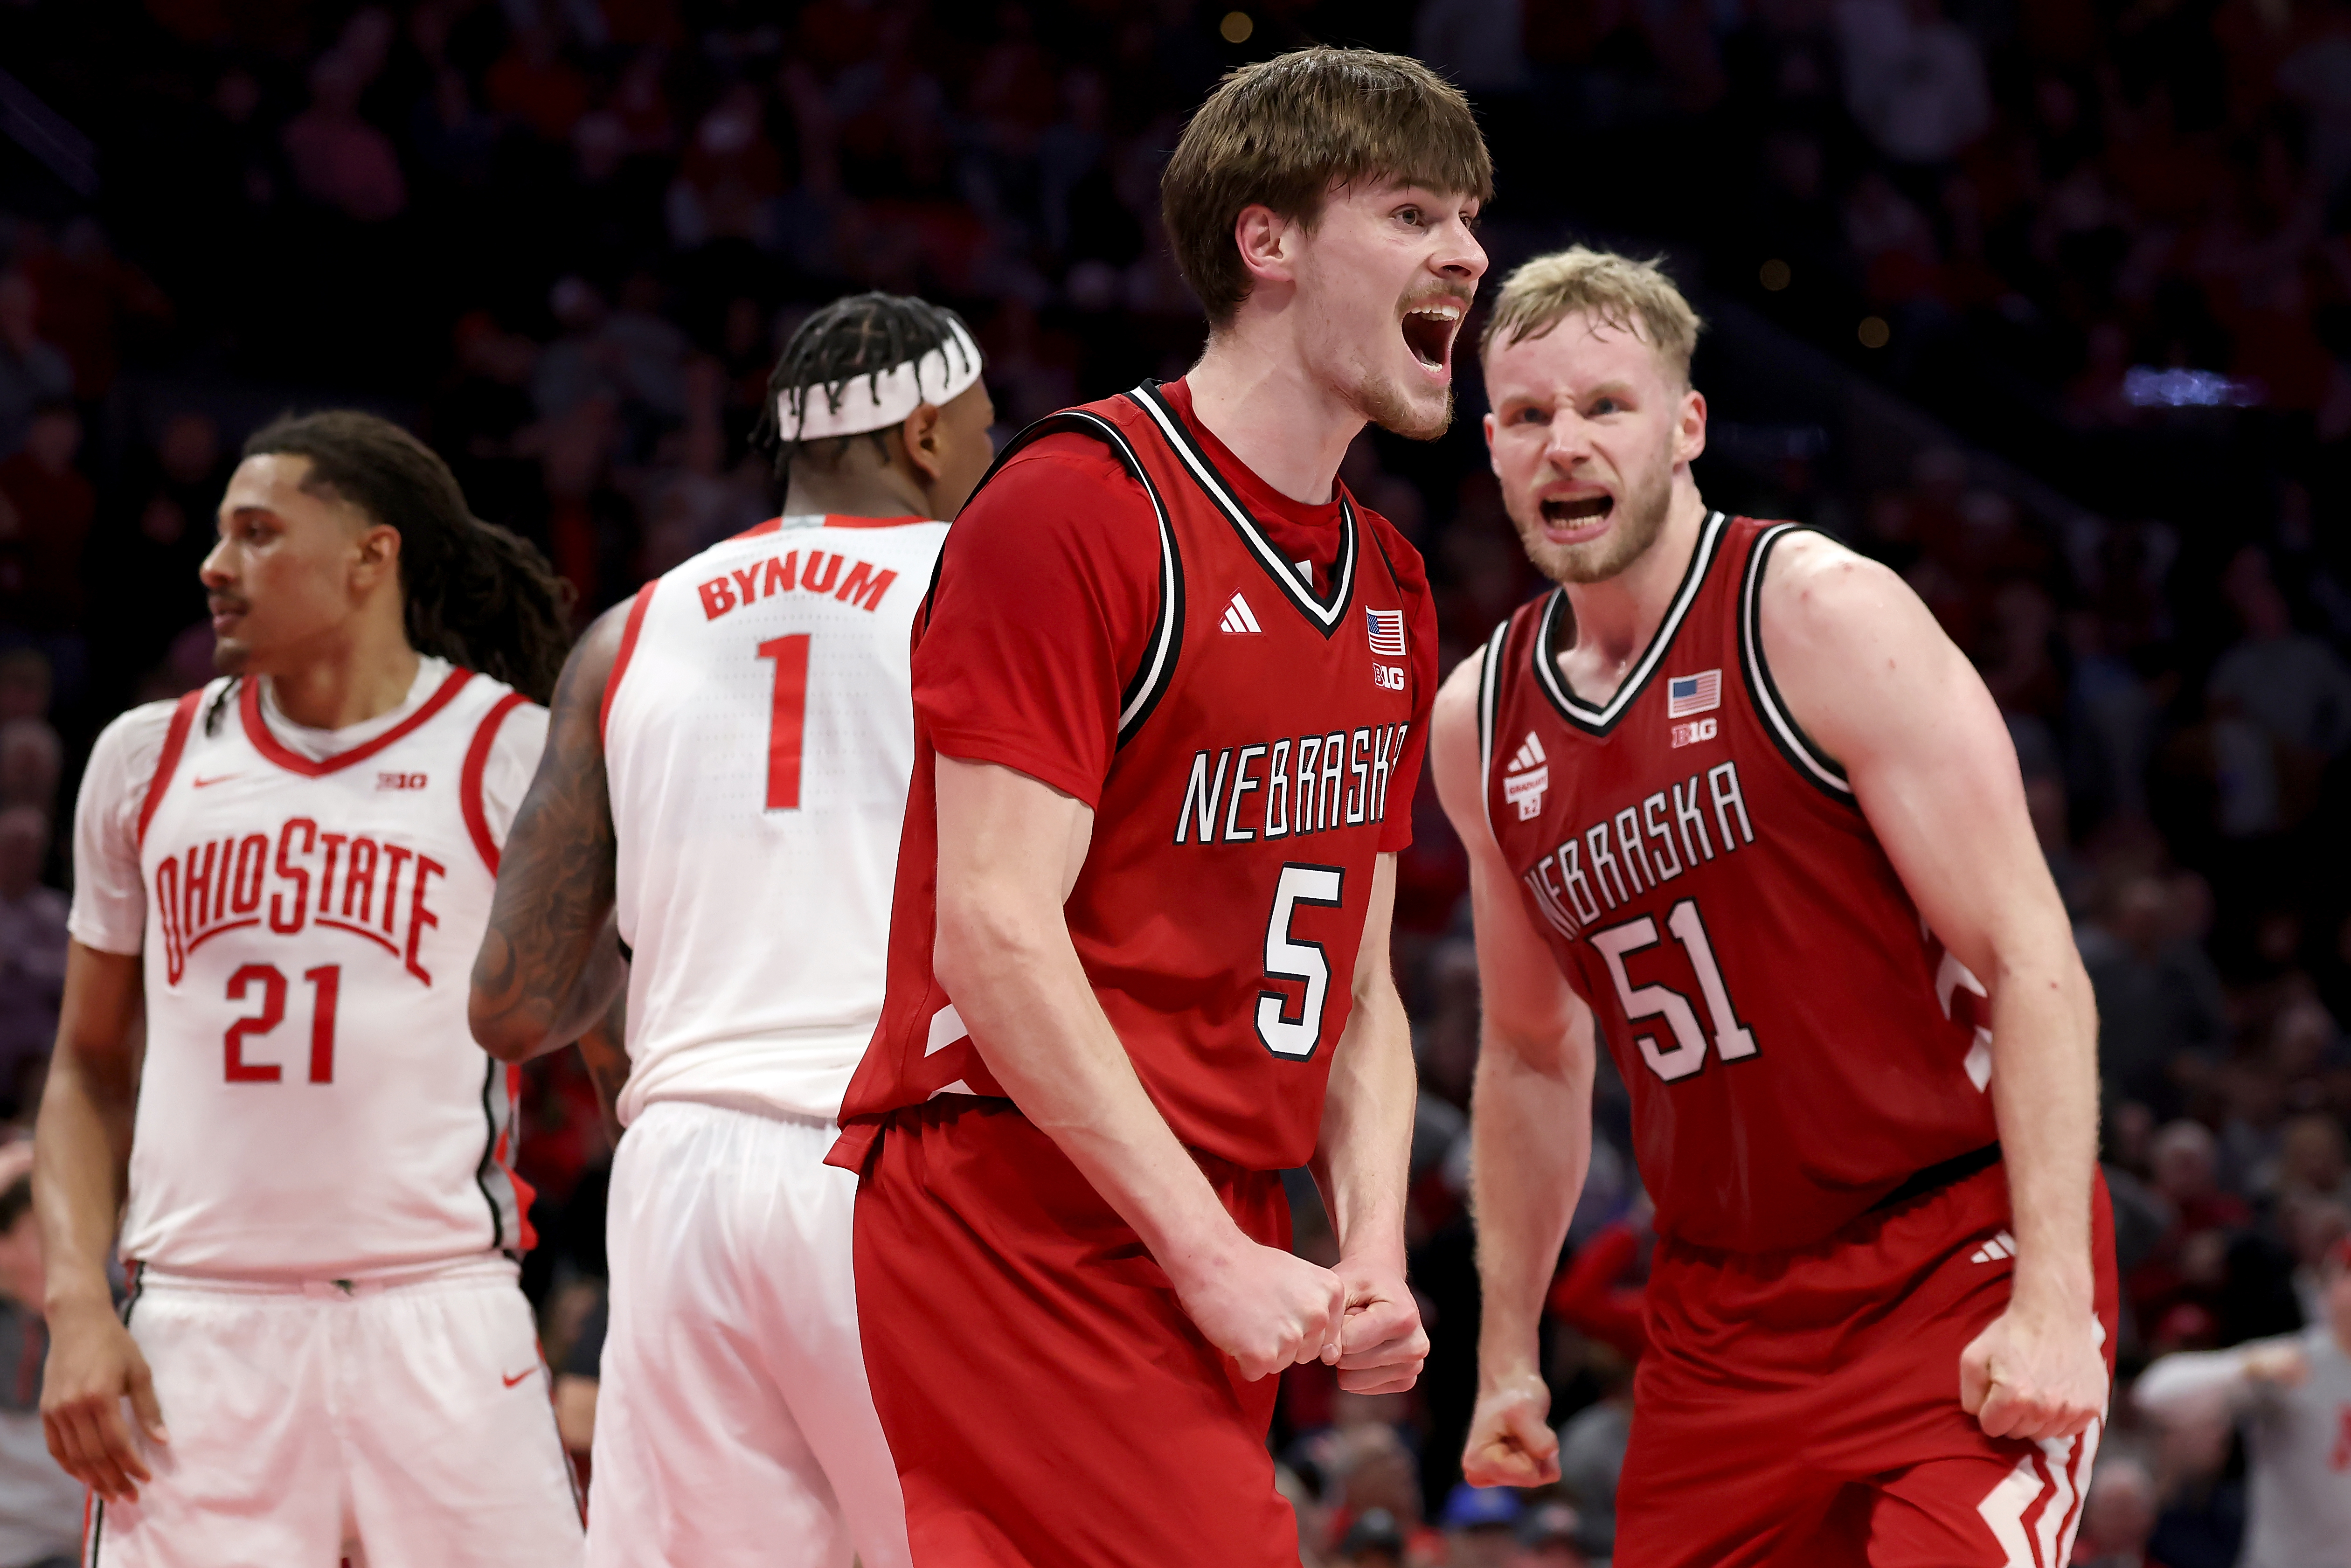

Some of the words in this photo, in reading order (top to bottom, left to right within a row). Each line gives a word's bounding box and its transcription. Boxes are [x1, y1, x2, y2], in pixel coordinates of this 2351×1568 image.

[698, 549, 899, 622] BYNUM
[755, 632, 811, 814] 1
[157, 834, 269, 986] OHIO
[270, 817, 445, 987] STATE
[1522, 760, 1755, 941] NEBRASKA
[224, 964, 341, 1084] 21
[1254, 861, 1345, 1062] 5
[1586, 895, 1761, 1085] 51
